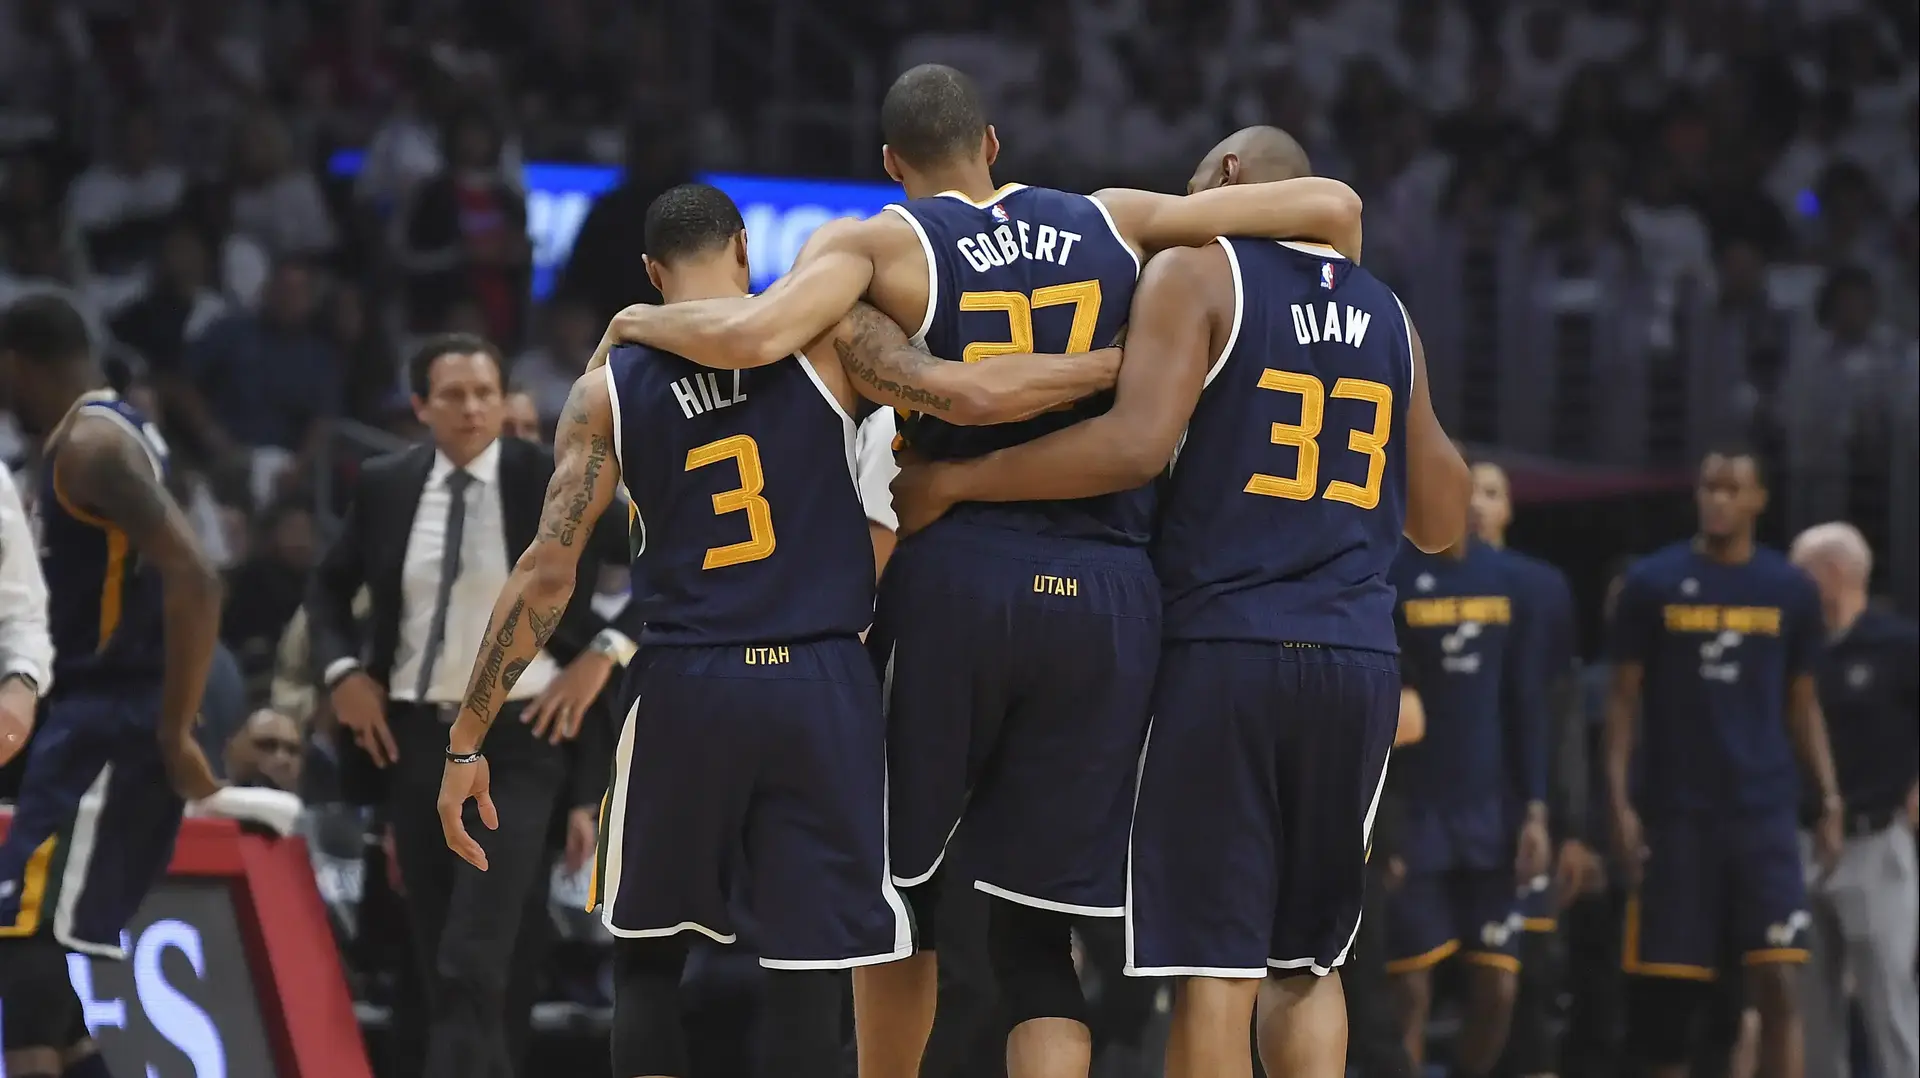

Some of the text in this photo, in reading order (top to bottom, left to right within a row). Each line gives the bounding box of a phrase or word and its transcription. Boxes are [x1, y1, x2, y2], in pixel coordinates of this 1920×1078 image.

[957, 219, 1082, 273] GOBERT
[959, 278, 1102, 364] 27
[1290, 301, 1372, 349] DIAW
[669, 368, 748, 420] HILL
[1242, 367, 1394, 511] 33
[684, 433, 777, 571] 3
[1033, 574, 1079, 597] UTAH
[744, 645, 791, 666] UTAH
